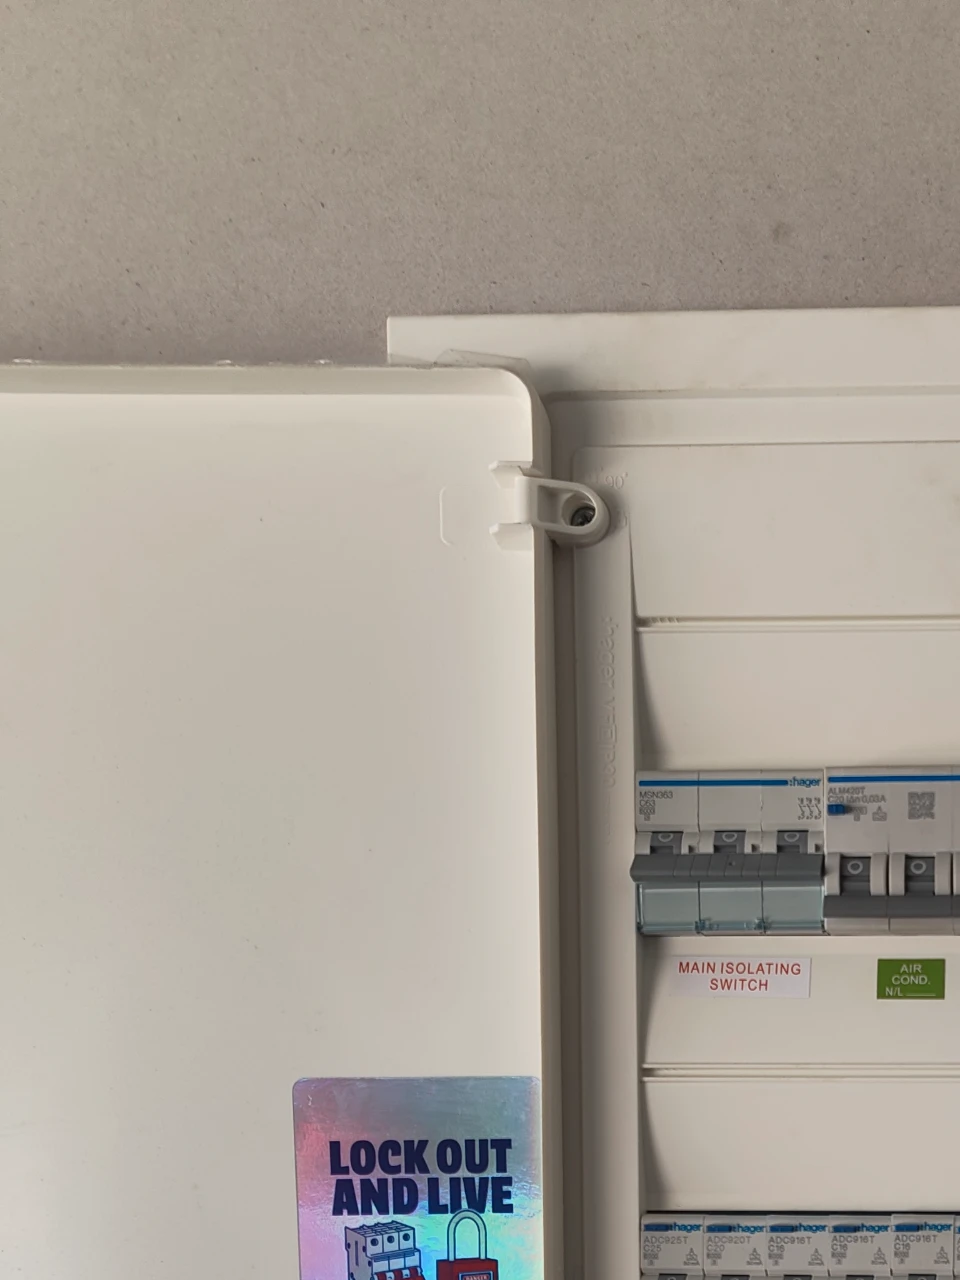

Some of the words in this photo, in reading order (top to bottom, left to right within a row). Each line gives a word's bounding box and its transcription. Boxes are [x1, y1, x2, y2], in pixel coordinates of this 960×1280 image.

[639, 790, 673, 799] MSN363
[828, 795, 844, 803] C20
[639, 799, 656, 807] C63
[678, 961, 716, 975] MAIN
[720, 962, 802, 976] ISOLATING
[899, 963, 923, 974] AIR
[891, 974, 931, 986] COND.
[709, 978, 769, 992] SWITCH
[329, 1139, 431, 1176] LOCK
[436, 1138, 512, 1175] OUT
[331, 1177, 419, 1217] AND
[427, 1176, 514, 1215] LIVE
[643, 1236, 689, 1245] ADC925T
[706, 1236, 752, 1245] ADC920T
[768, 1236, 812, 1245] ADC916T
[831, 1235, 875, 1244] ADC916T
[894, 1234, 938, 1243] ADC916T
[831, 1243, 848, 1251] C16
